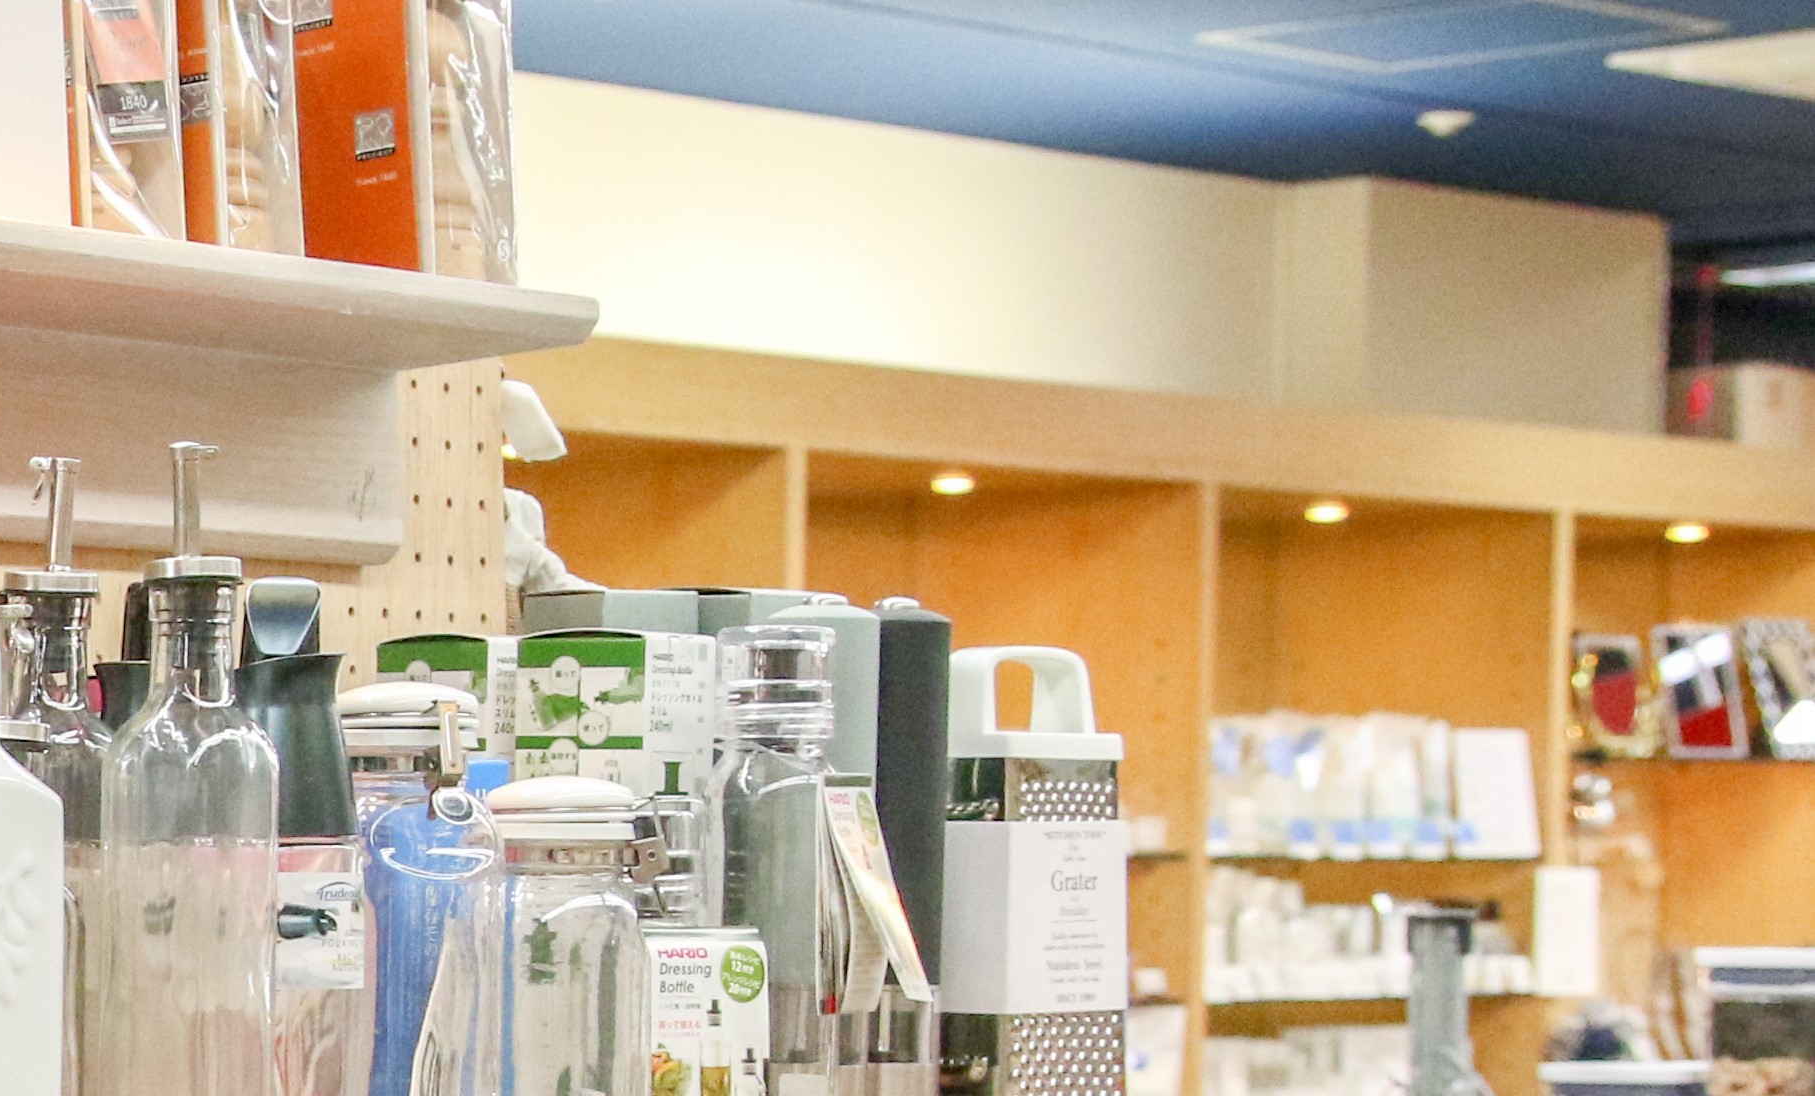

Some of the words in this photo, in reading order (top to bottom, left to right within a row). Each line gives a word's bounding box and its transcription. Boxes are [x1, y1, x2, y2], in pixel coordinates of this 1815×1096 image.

[120, 94, 148, 111] 1840
[1050, 869, 1099, 892] Grater
[657, 947, 709, 959] HARIO
[658, 962, 713, 979] Dressing
[658, 980, 696, 994] Bottle
